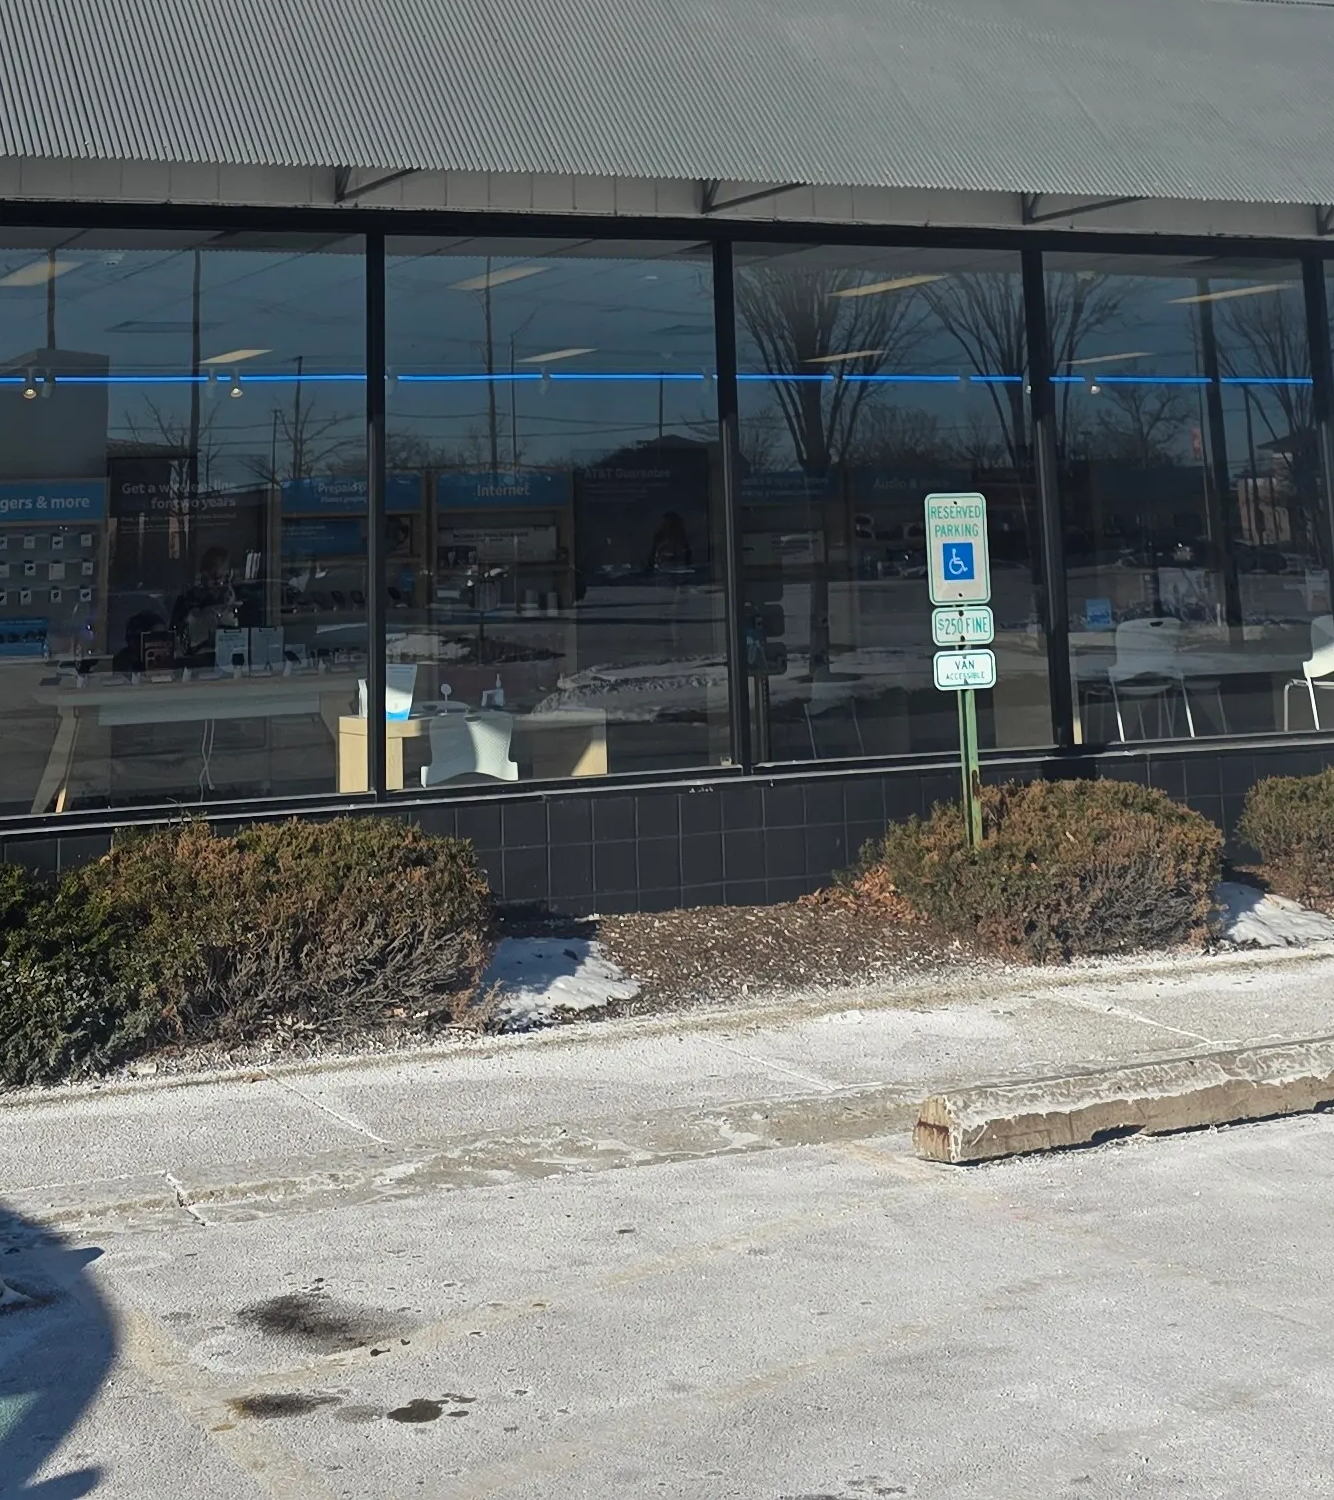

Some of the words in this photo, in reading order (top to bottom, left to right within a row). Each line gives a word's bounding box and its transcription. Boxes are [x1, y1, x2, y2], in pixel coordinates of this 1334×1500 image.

[122, 482, 145, 494] Get
[477, 483, 531, 497] Internet
[36, 495, 48, 509] &
[50, 497, 90, 509] more
[930, 505, 981, 520] RESERVED
[934, 523, 979, 538] PARKING
[937, 617, 964, 635] $250
[966, 616, 988, 633] FINE
[954, 659, 975, 670] VAN
[945, 671, 986, 680] ACCESSIBLE
